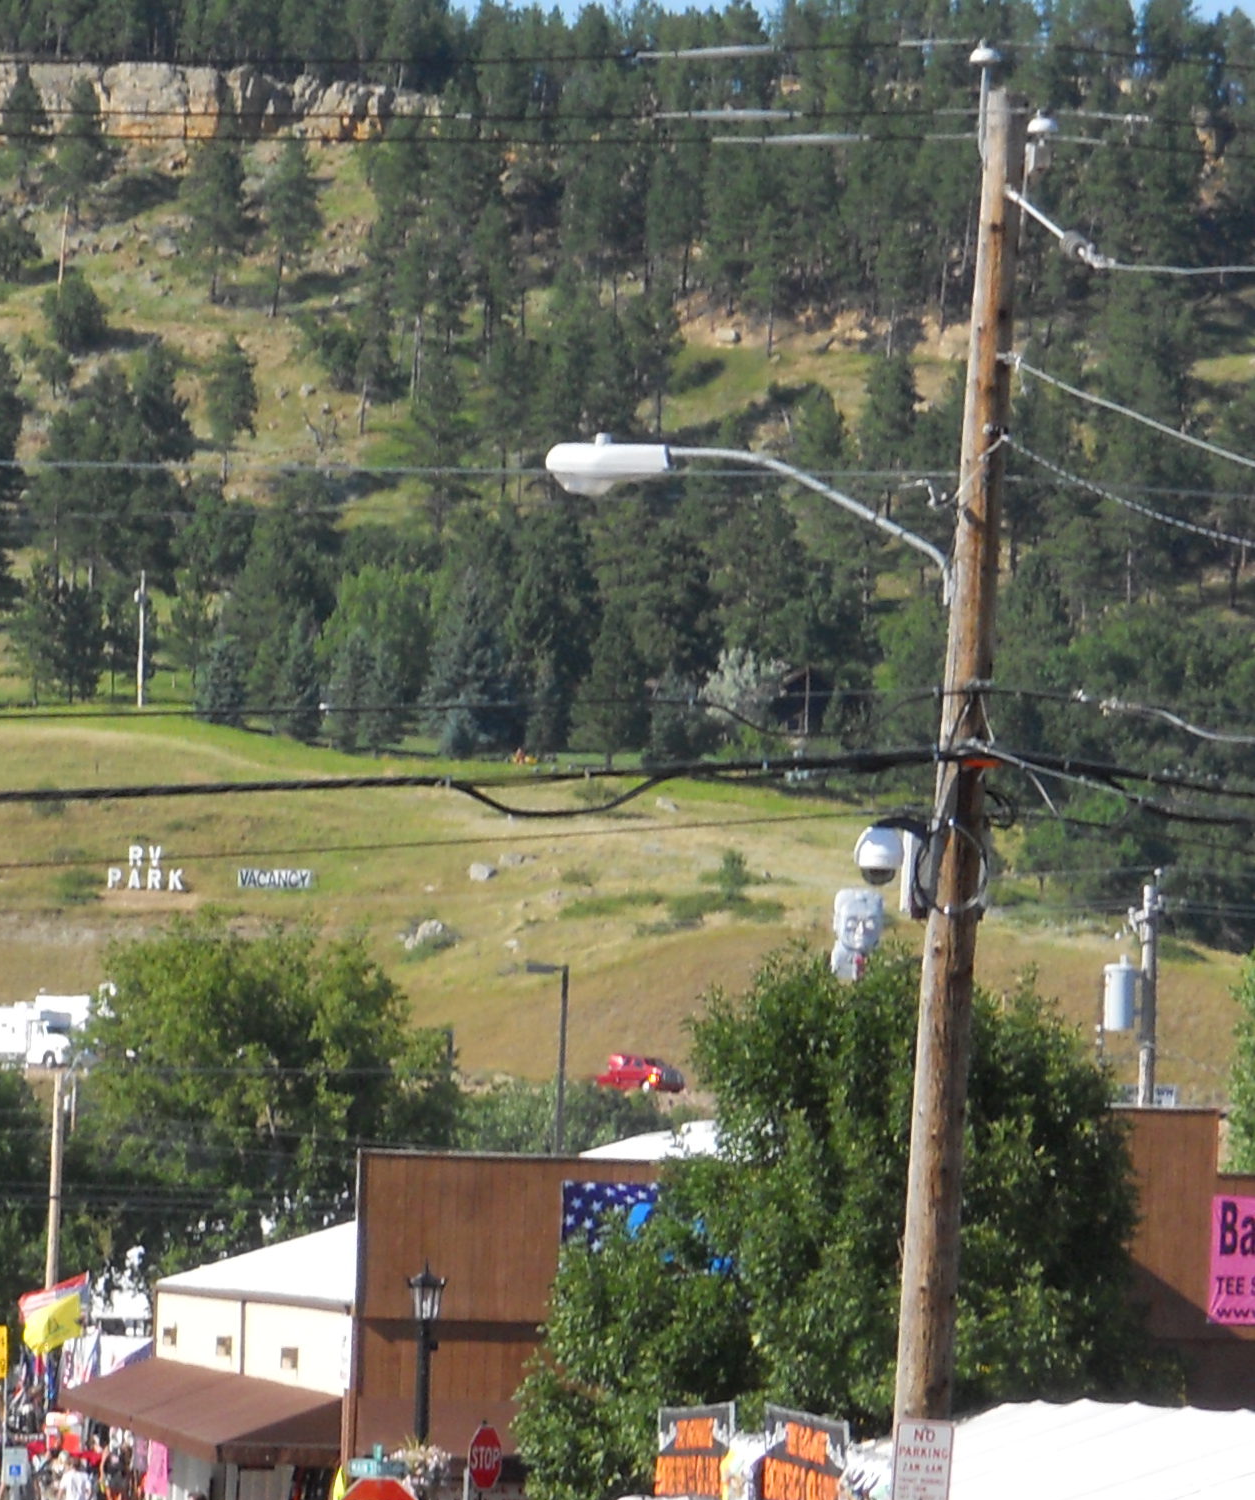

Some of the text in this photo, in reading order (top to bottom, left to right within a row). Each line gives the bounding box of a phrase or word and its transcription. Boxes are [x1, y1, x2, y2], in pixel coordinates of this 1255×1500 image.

[128, 845, 162, 867] RV
[107, 867, 185, 891] PARK
[239, 869, 308, 888] VACANCY
[1216, 1276, 1245, 1295] TEE
[914, 1428, 936, 1443] NO
[470, 1447, 501, 1470] STOP
[898, 1447, 948, 1460] PARKING
